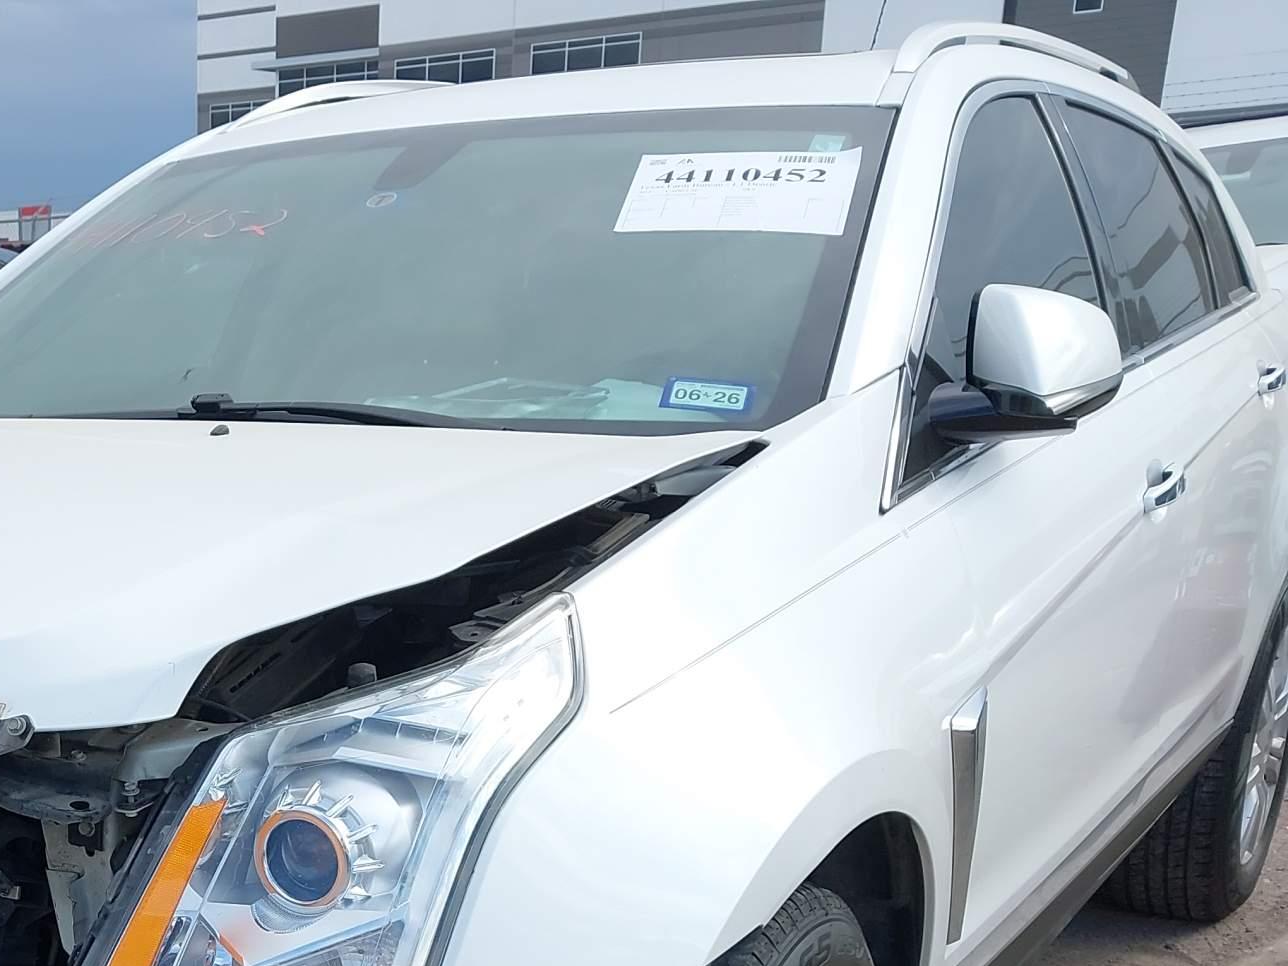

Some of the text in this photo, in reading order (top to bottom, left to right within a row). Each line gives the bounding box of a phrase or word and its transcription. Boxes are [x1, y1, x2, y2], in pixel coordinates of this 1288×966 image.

[655, 167, 828, 184] 44110452
[674, 388, 741, 404] 06 26
